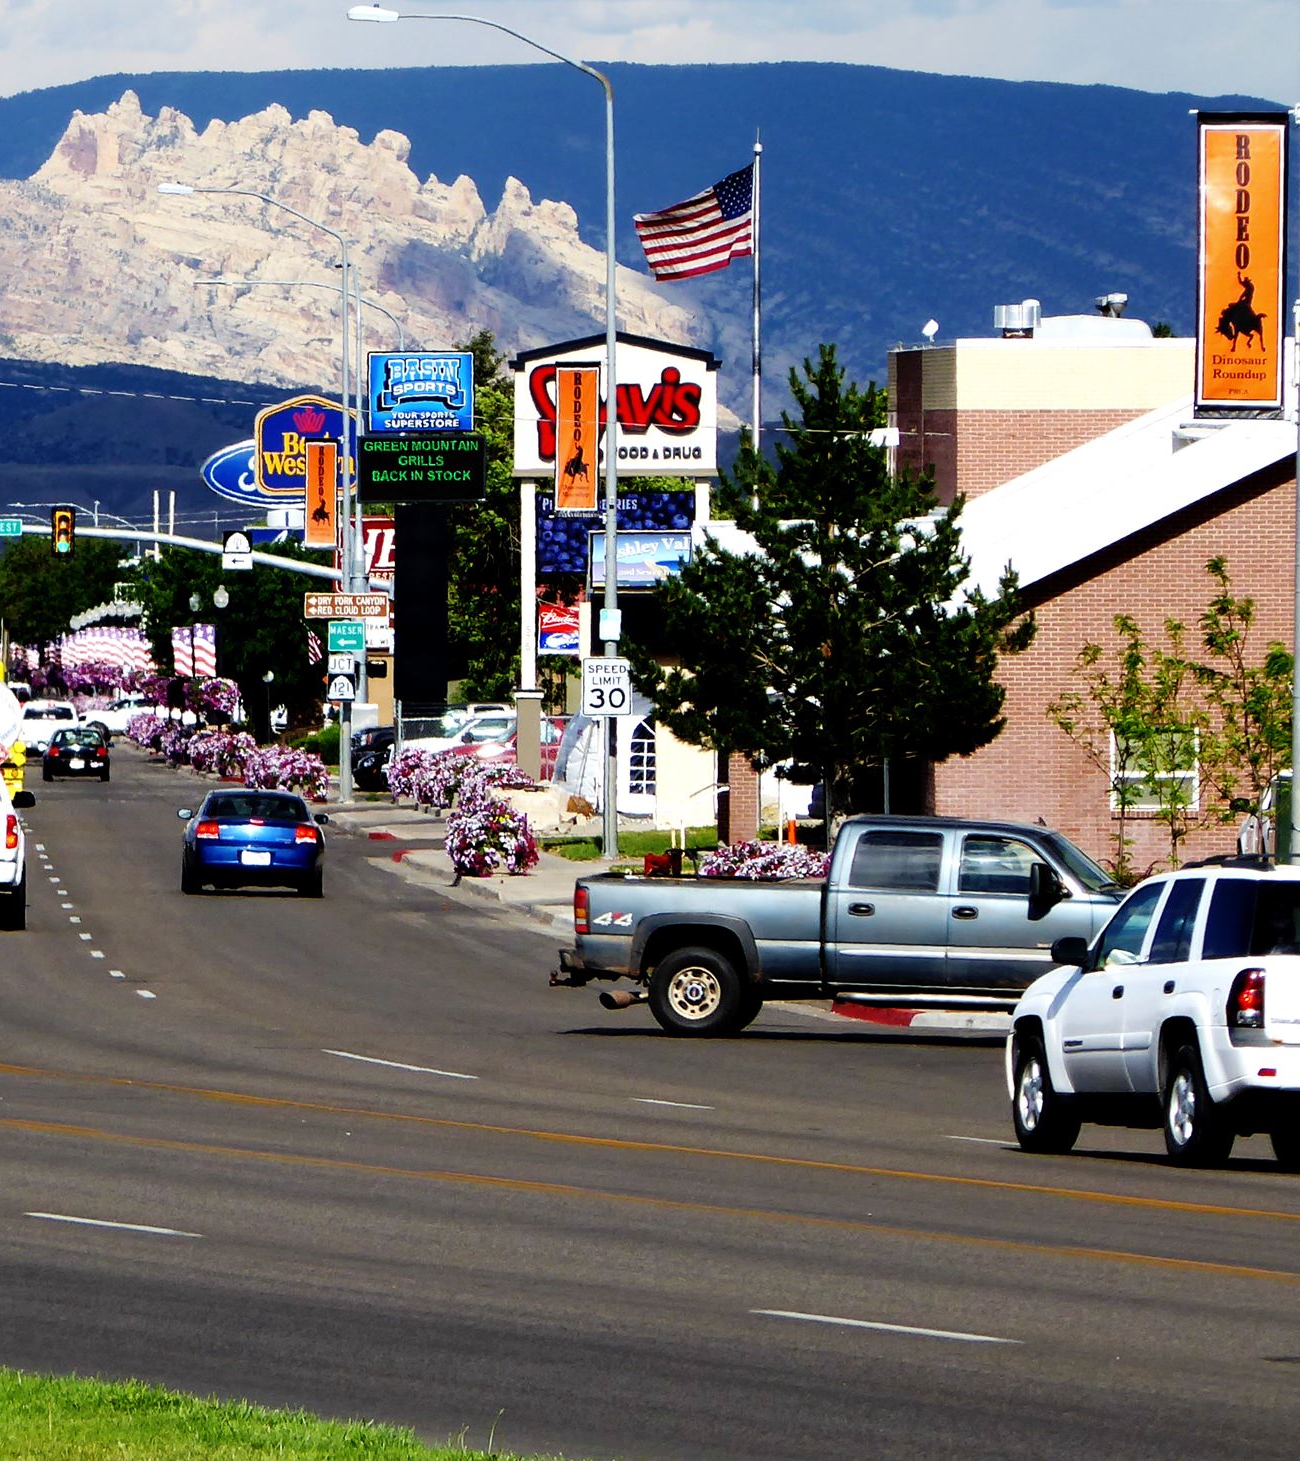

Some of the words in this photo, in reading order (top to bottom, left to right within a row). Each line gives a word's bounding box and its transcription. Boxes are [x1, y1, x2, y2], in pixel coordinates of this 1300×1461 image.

[1235, 133, 1251, 270] RODEO
[1212, 354, 1267, 366] Dinosaur
[387, 359, 460, 382] BASIN
[1212, 368, 1267, 382] Roundup
[392, 381, 457, 396] SPORTS
[573, 371, 582, 442] RODEO
[392, 411, 417, 419] YOUR
[420, 411, 455, 419] SPORTS
[384, 418, 460, 428] SUPERSTORE
[364, 441, 408, 451] GREEN
[411, 440, 479, 451] MOUNTAIN
[617, 446, 650, 460] OOD
[663, 446, 702, 460] DRUG
[398, 455, 444, 467] GRILLS
[372, 470, 408, 482] BACK
[411, 470, 423, 481] IN
[427, 470, 471, 481] STOCK
[617, 538, 659, 557] shley
[317, 596, 333, 605] DRY
[335, 596, 354, 605] FORK
[356, 596, 386, 605] CANYON
[317, 605, 333, 615] RED
[335, 605, 359, 615] CLOUD
[361, 605, 381, 615] LOOP
[330, 625, 364, 635] MAESER
[331, 658, 352, 670] JCT
[588, 664, 627, 674] SPEED
[592, 676, 622, 686] LIMIT
[333, 682, 350, 693] 121
[589, 687, 626, 709] 30
